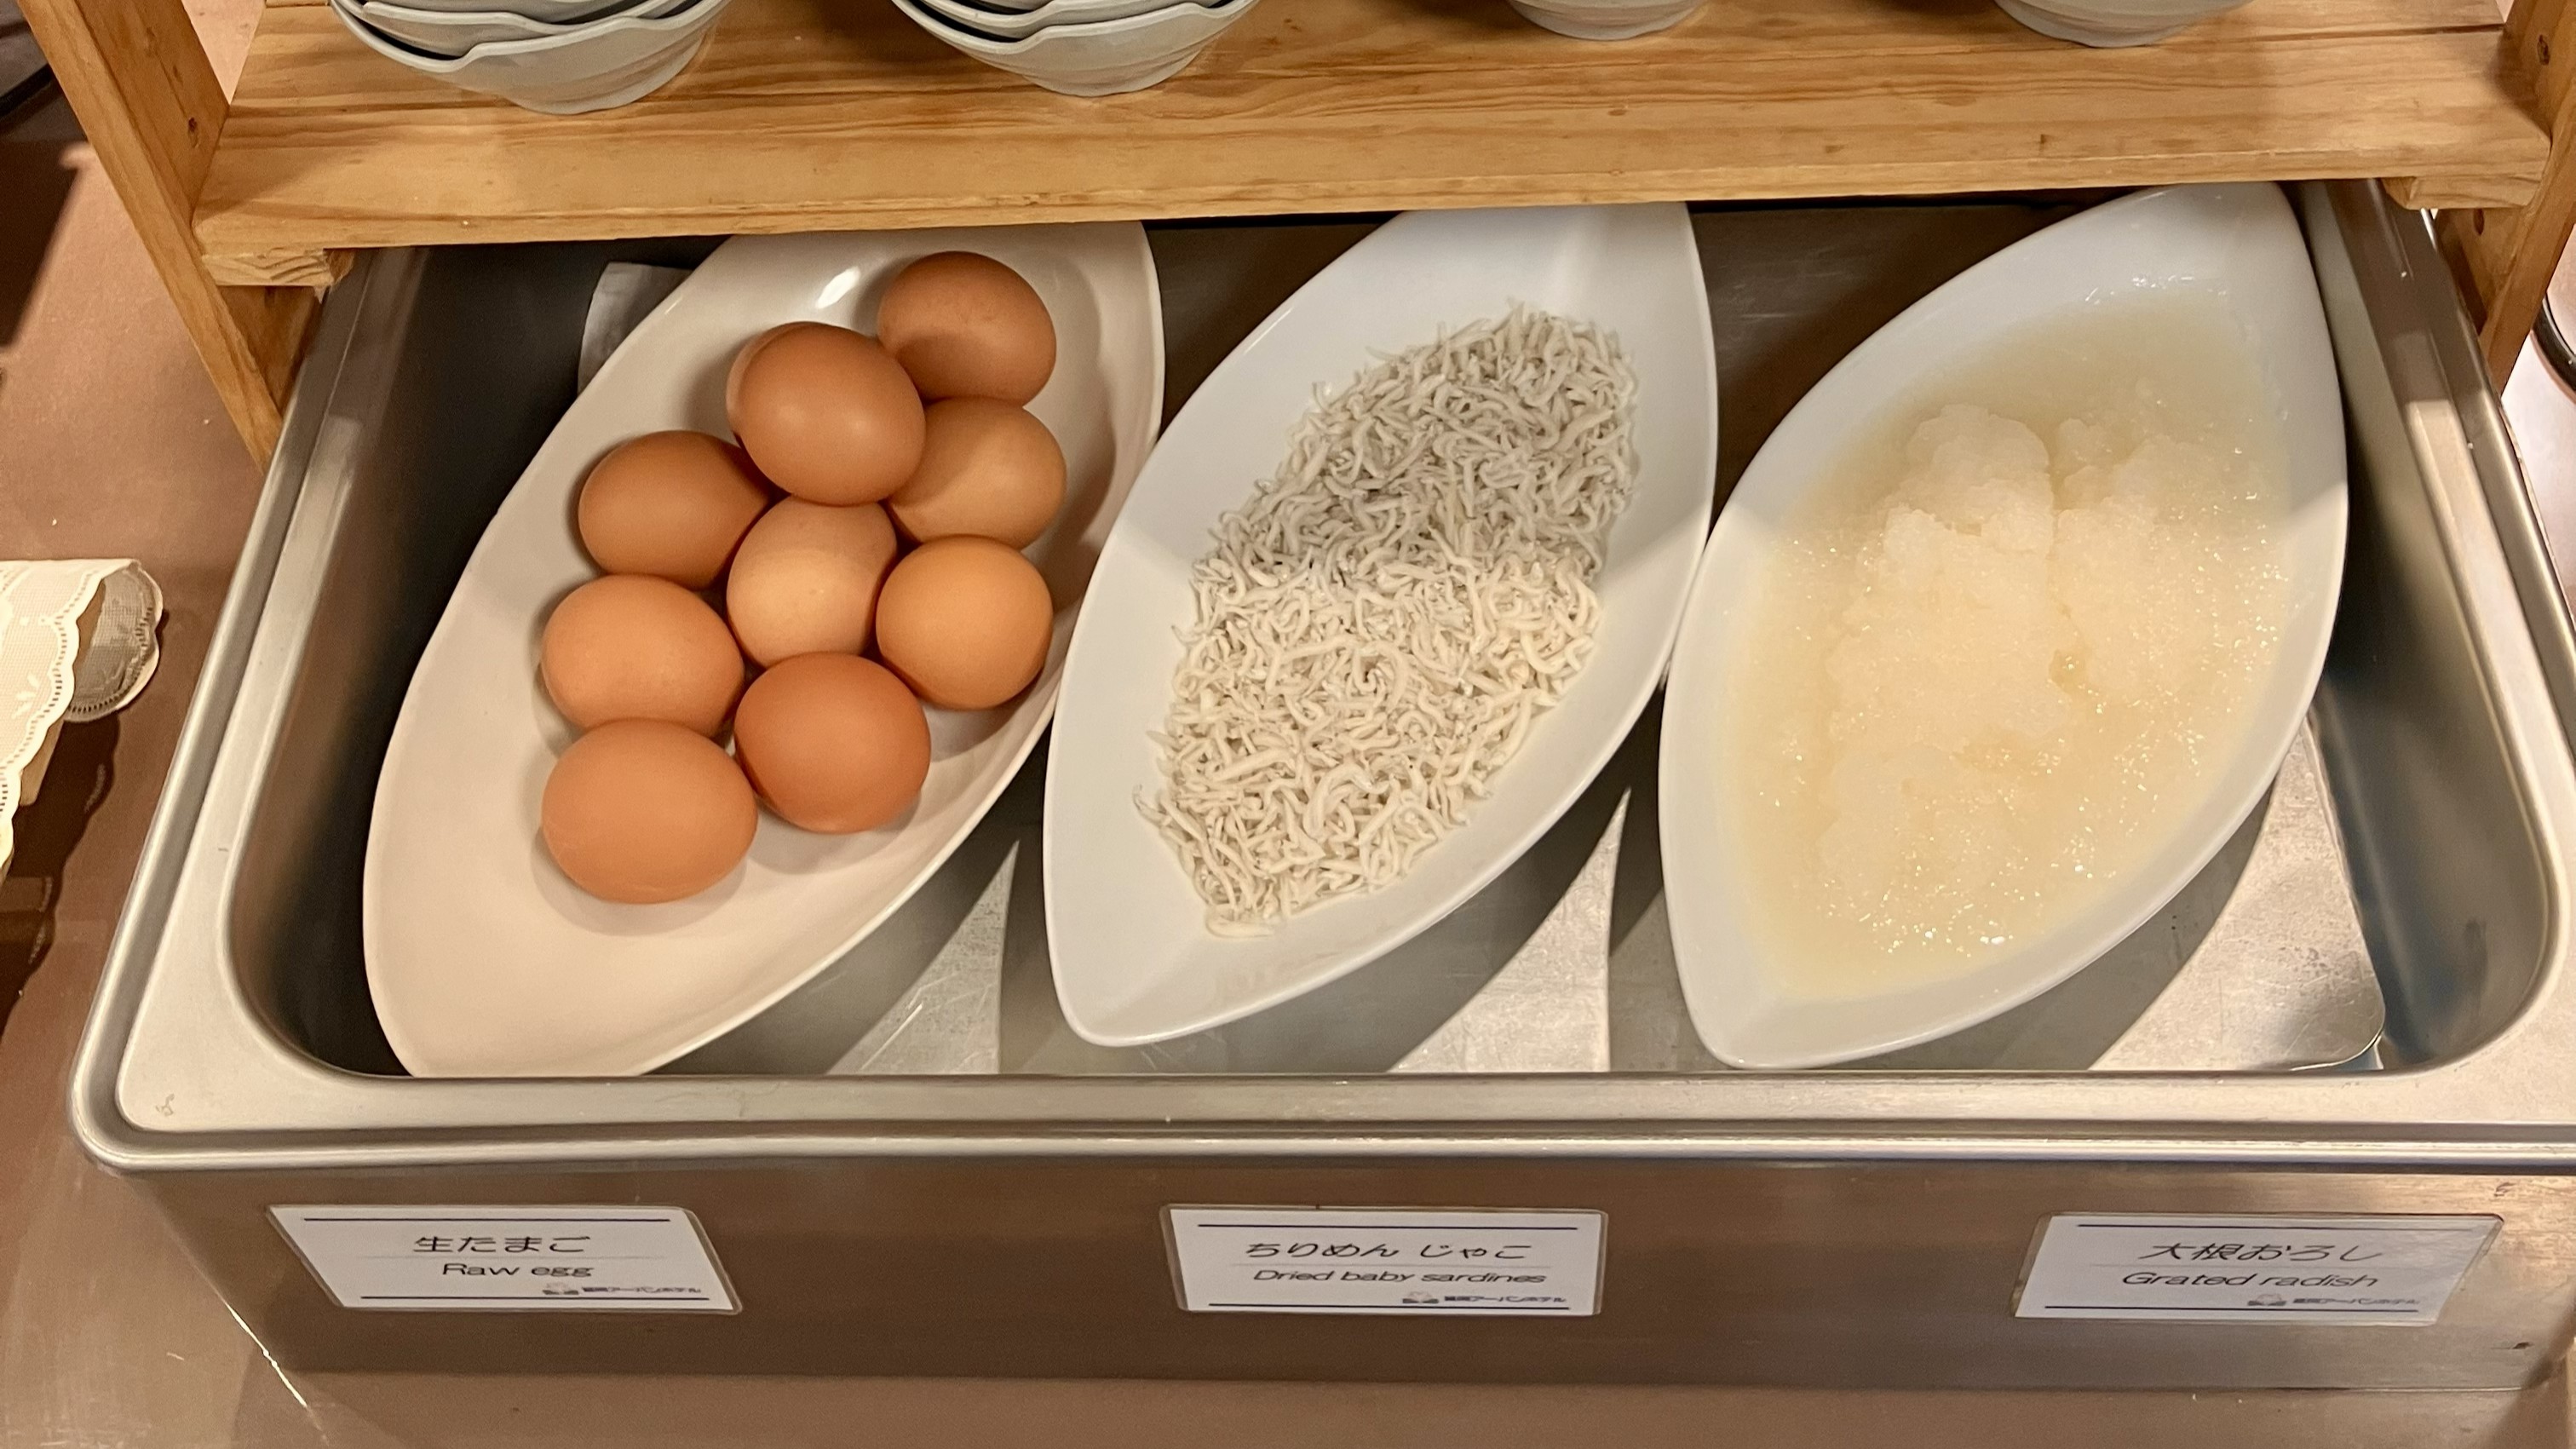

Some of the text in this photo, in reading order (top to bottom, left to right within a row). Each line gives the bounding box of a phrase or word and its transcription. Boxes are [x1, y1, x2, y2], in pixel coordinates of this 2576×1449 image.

[413, 1235, 591, 1253] 生たまご
[1245, 1242, 1532, 1260] ちりめん じゃこ
[2137, 1242, 2383, 1261] 大根おろし
[442, 1262, 595, 1277] Raw egg
[1253, 1269, 1547, 1284] Dried baby sardines
[2122, 1271, 2379, 1287] Grated radish
